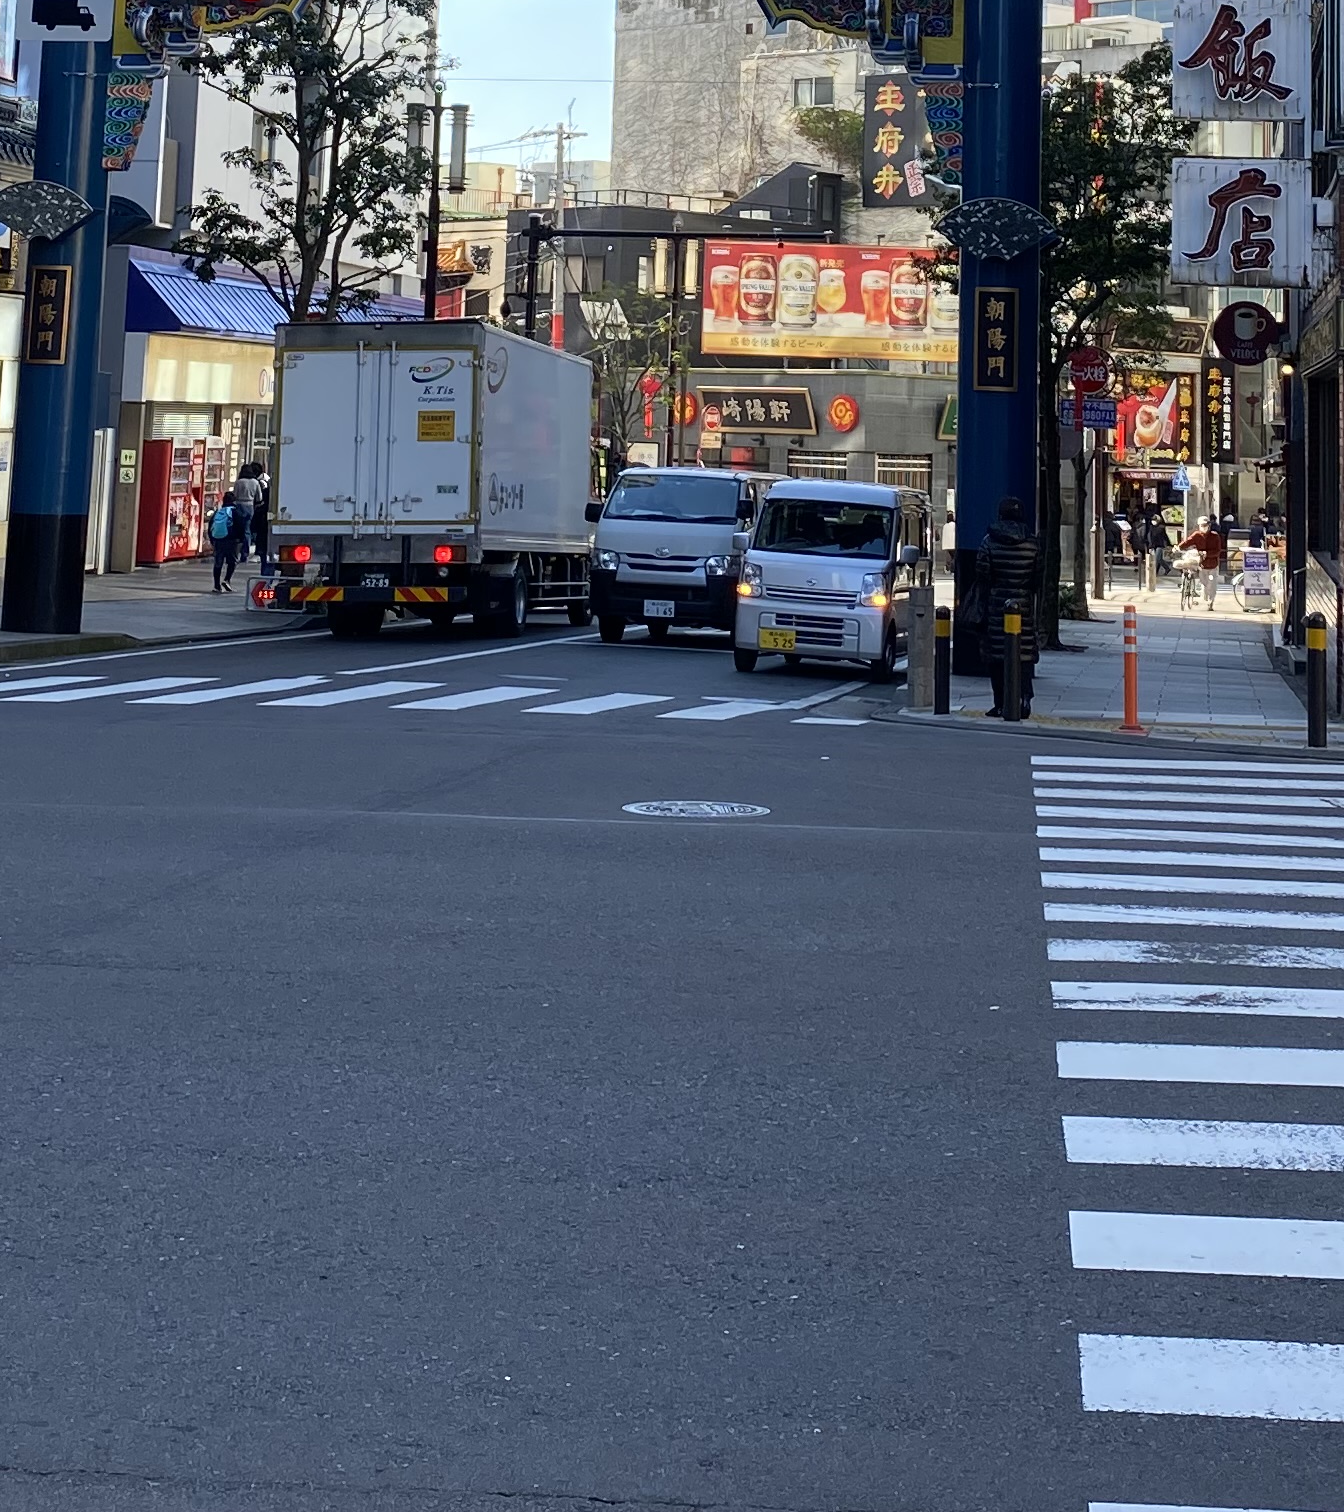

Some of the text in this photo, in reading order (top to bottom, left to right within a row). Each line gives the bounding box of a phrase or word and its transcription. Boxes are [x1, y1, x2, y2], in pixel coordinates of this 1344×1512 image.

[872, 85, 906, 196] 王府井
[37, 274, 58, 352] 朝陽門
[985, 297, 1007, 379] 朝陽門
[722, 396, 791, 423] 崎陽軒
